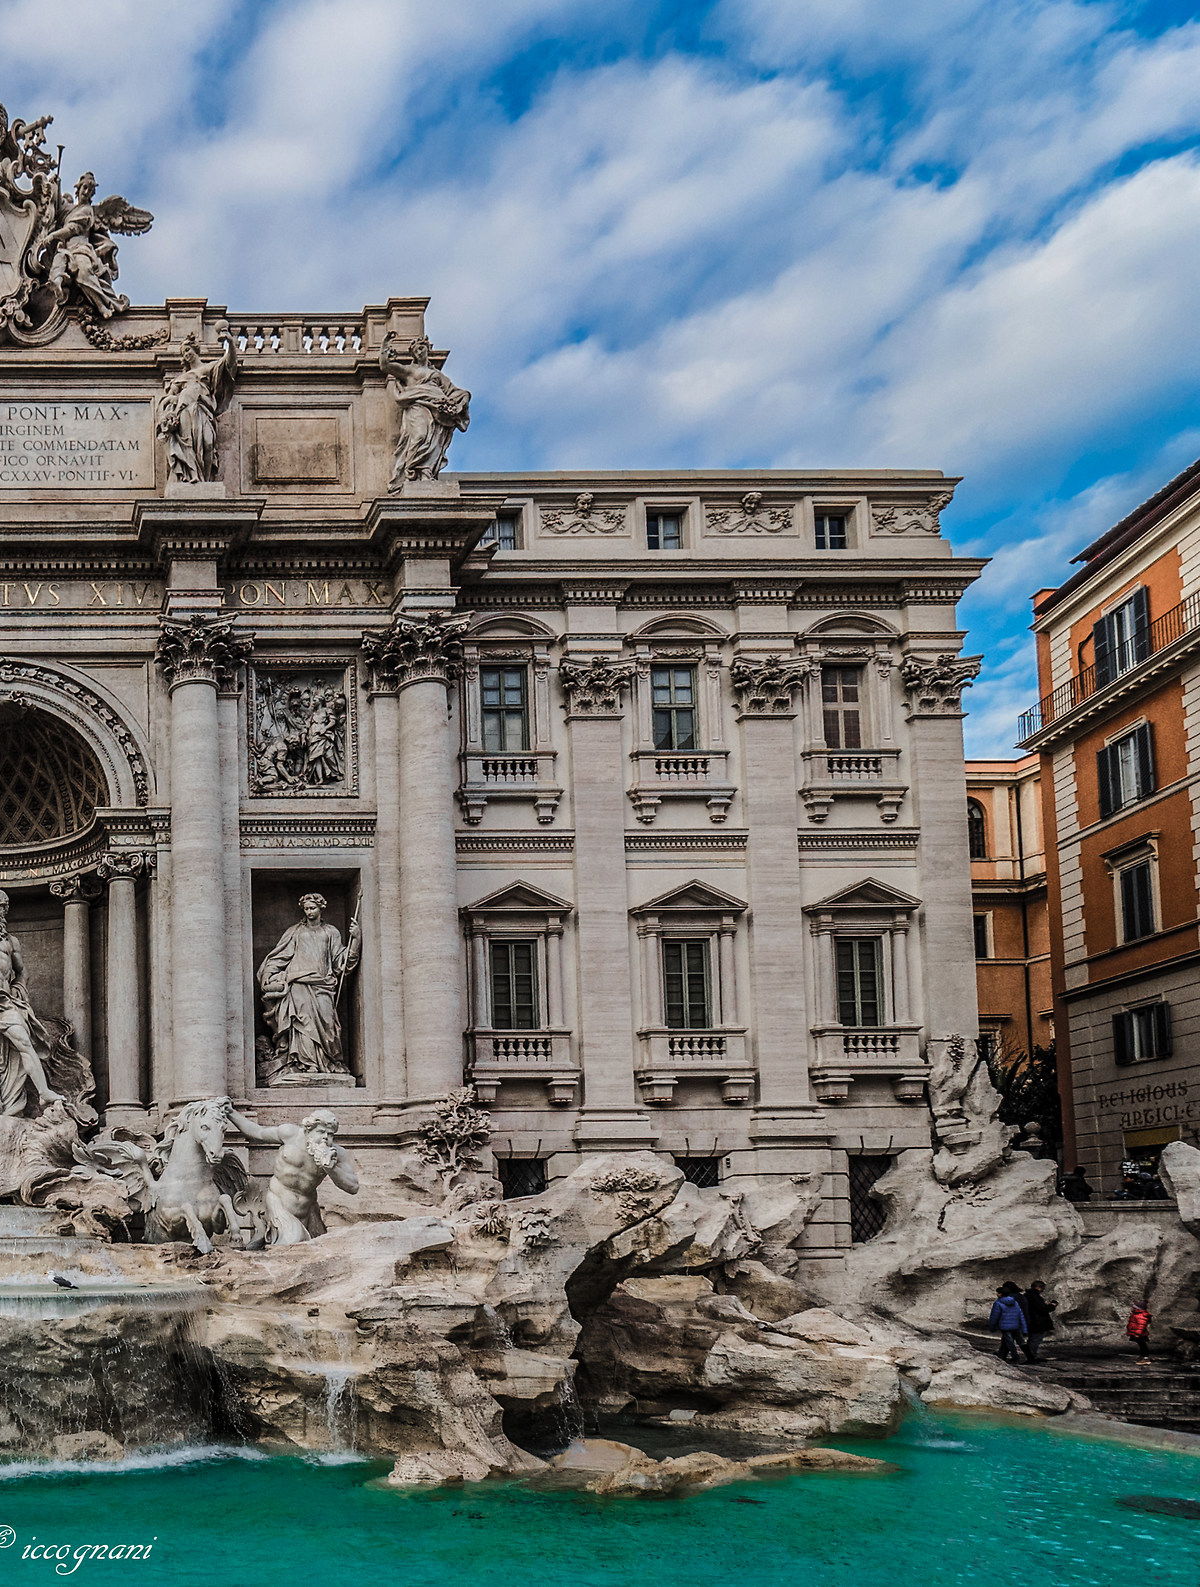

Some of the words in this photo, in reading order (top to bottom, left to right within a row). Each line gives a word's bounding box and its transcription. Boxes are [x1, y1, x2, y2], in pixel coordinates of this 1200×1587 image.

[23, 440, 140, 451] COMMENDATAM
[36, 455, 104, 467] ORNAVIT
[1099, 1080, 1188, 1109] RELIGIOUS
